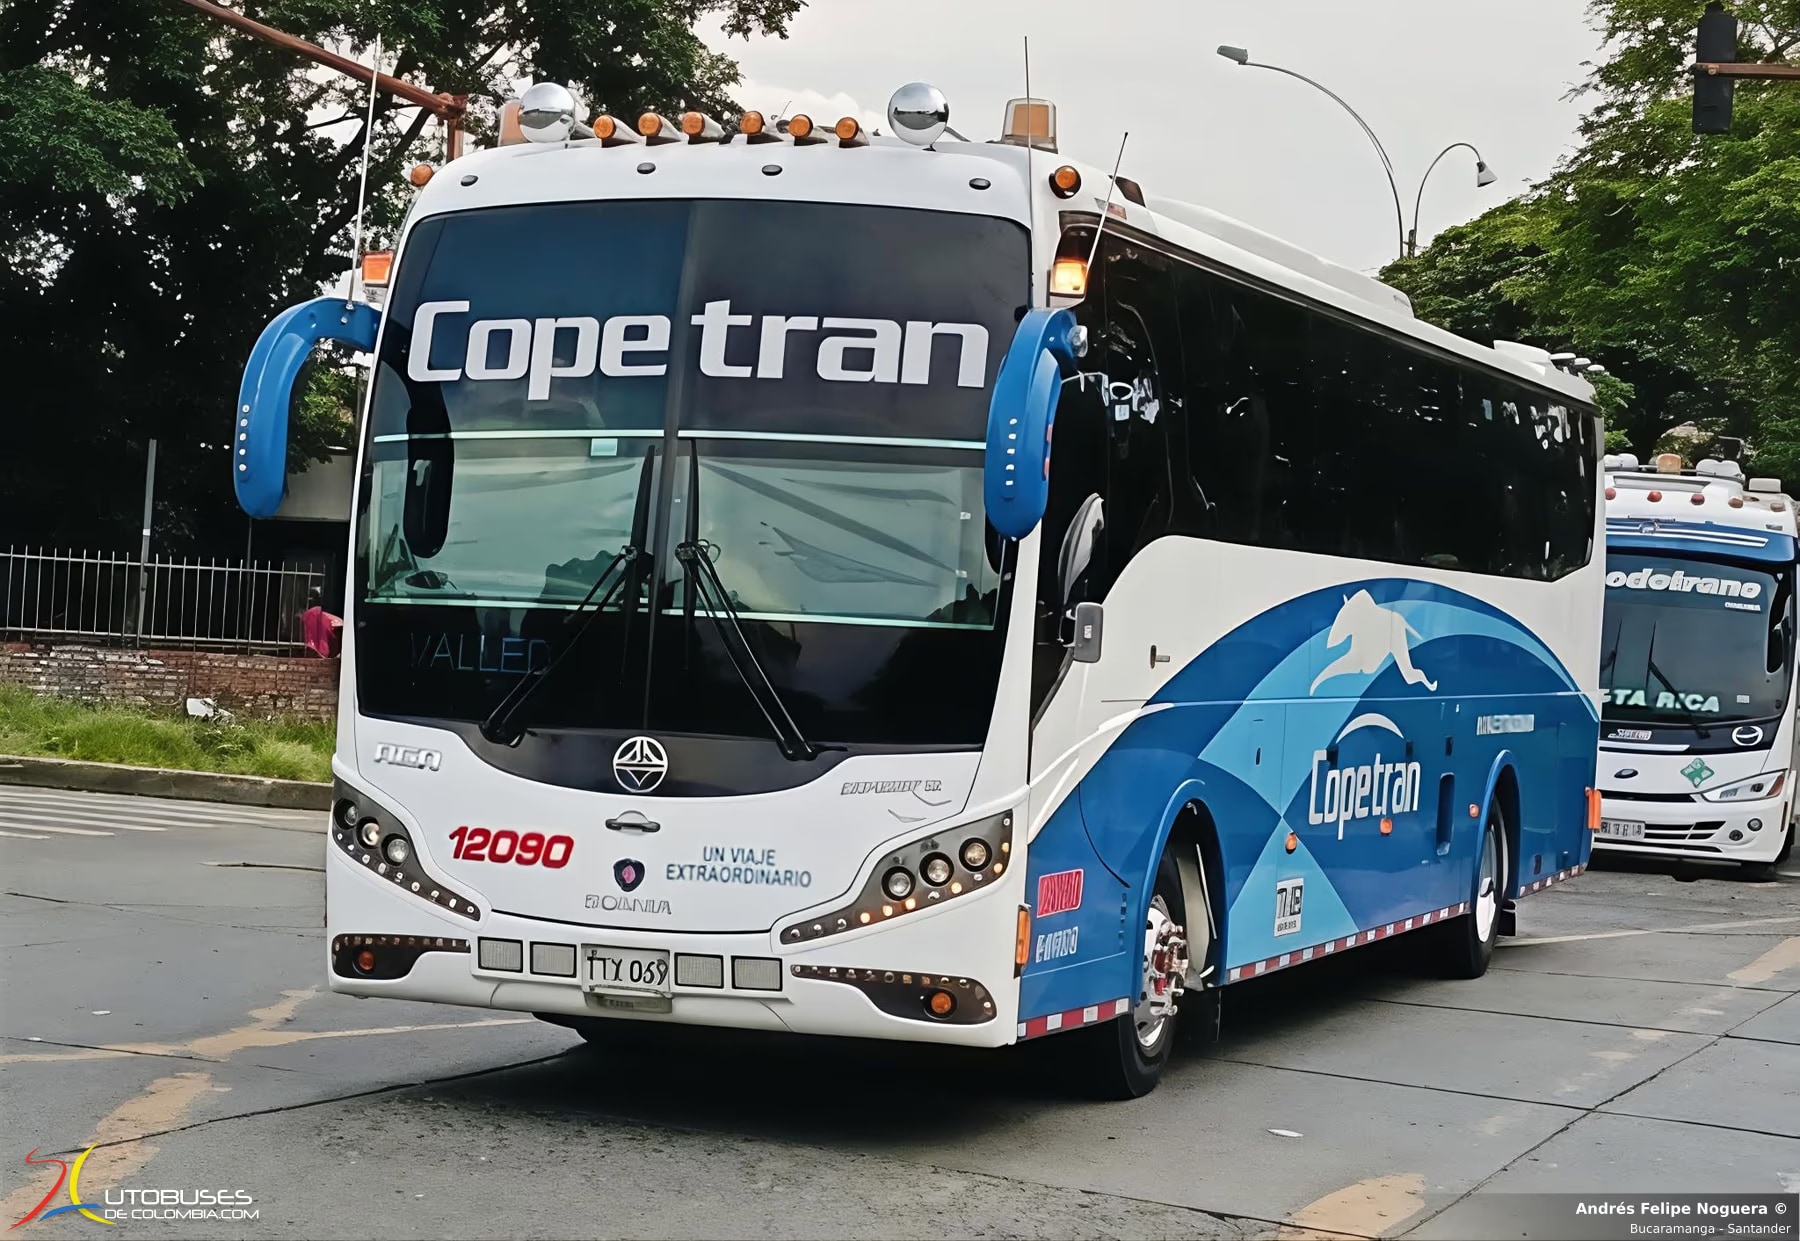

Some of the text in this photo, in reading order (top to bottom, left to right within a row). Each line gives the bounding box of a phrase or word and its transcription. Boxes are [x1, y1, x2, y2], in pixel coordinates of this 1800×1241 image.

[407, 299, 989, 401] Copetran
[1308, 748, 1421, 840] Copetran
[449, 825, 575, 870] 12090
[703, 846, 776, 867] UN VIAJE
[666, 863, 812, 888] EXTRAORDINARIO
